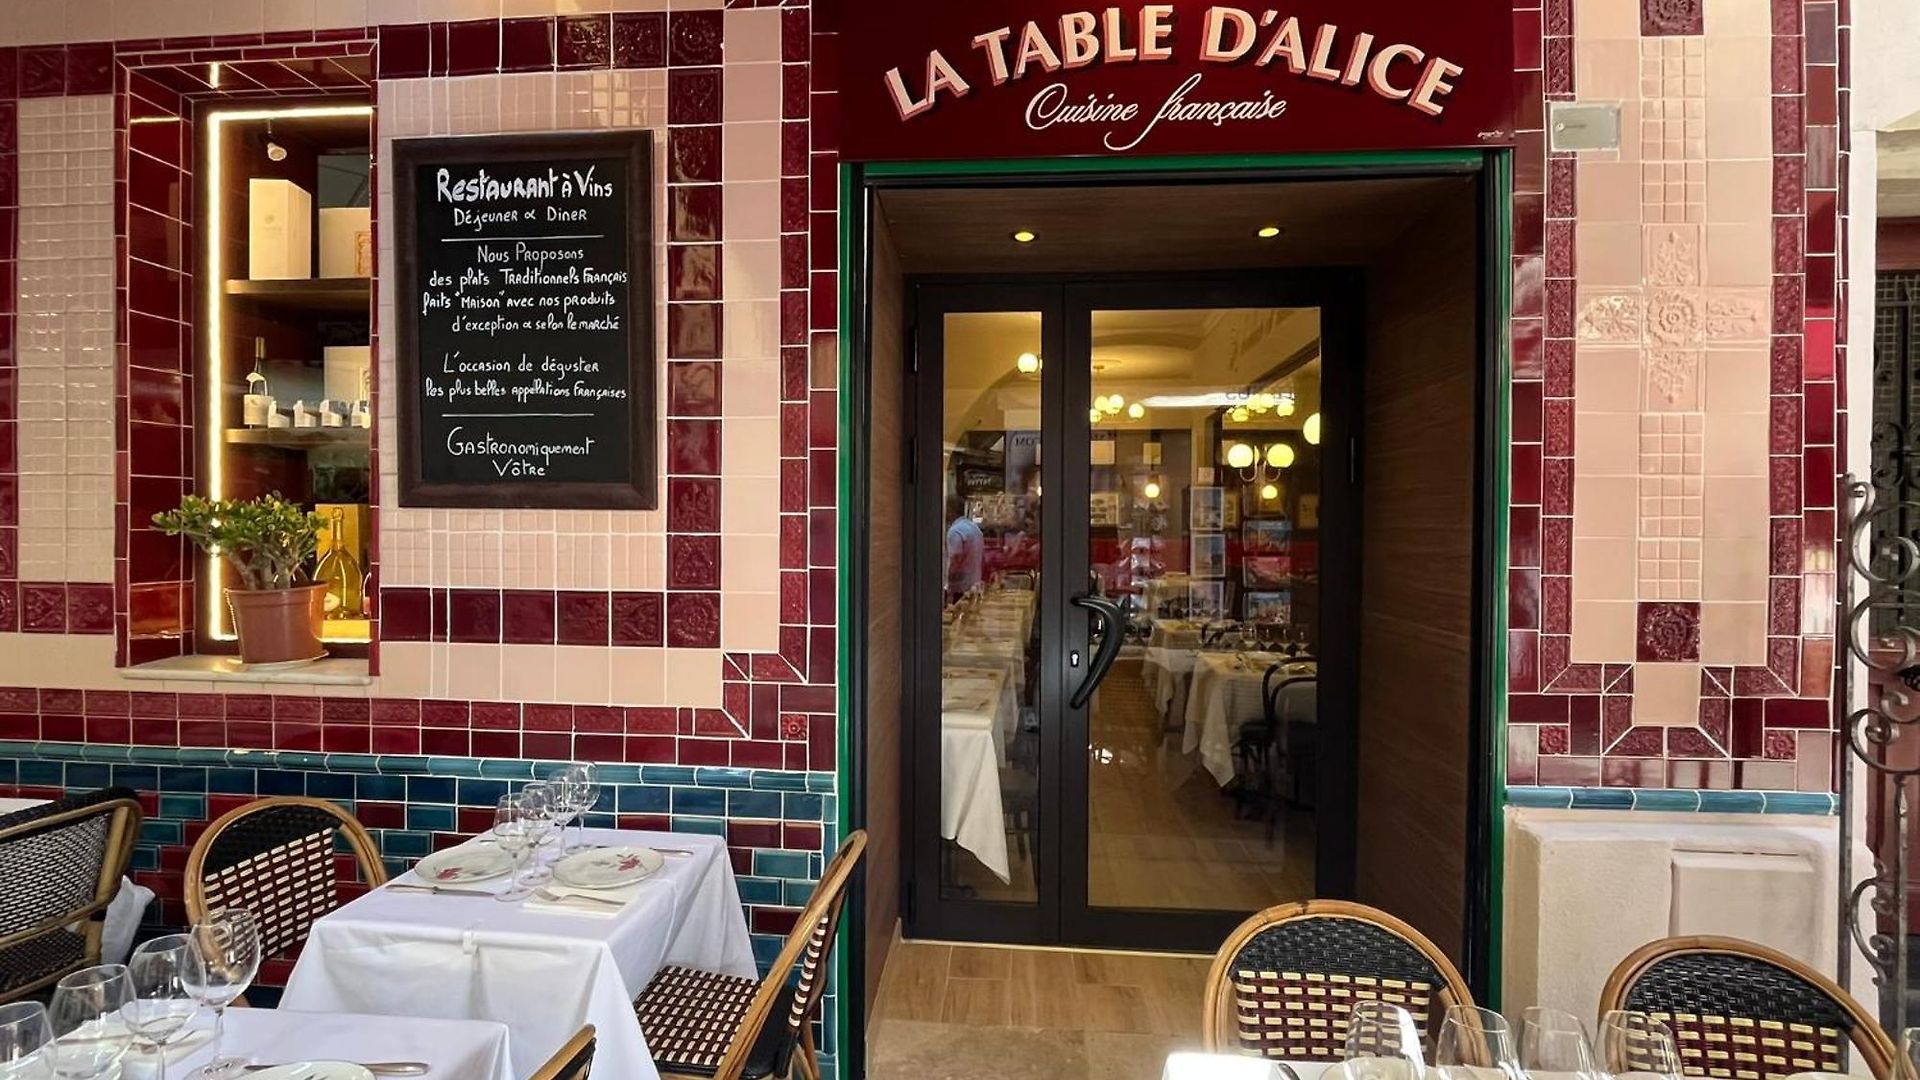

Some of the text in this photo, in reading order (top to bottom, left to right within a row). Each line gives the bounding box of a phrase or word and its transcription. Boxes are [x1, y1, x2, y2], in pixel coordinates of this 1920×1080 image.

[884, 4, 1463, 121] LA TABLE D'ALICE
[1025, 73, 1288, 151] Cuisine française
[437, 168, 559, 203] Restaurant
[574, 164, 613, 197] Vins
[454, 207, 518, 231] Déjeuner
[547, 206, 588, 222] Diner
[477, 241, 584, 273] Nous Proposons
[430, 266, 628, 293] des plats Traditionnels Français
[422, 291, 452, 317] faits
[506, 297, 535, 308] avec
[538, 297, 560, 307] nos
[563, 291, 616, 315] produits
[451, 314, 519, 337] d'exception
[535, 313, 564, 330] selon
[566, 312, 577, 330] le
[578, 315, 620, 331] marché
[443, 350, 600, 381] L'occasion de déguster
[425, 376, 444, 397] les
[448, 378, 473, 403] plus
[474, 378, 507, 397] belles
[573, 380, 627, 401] Françaises
[446, 426, 595, 466] Gastronomiquement
[492, 458, 546, 477] Vôtre
